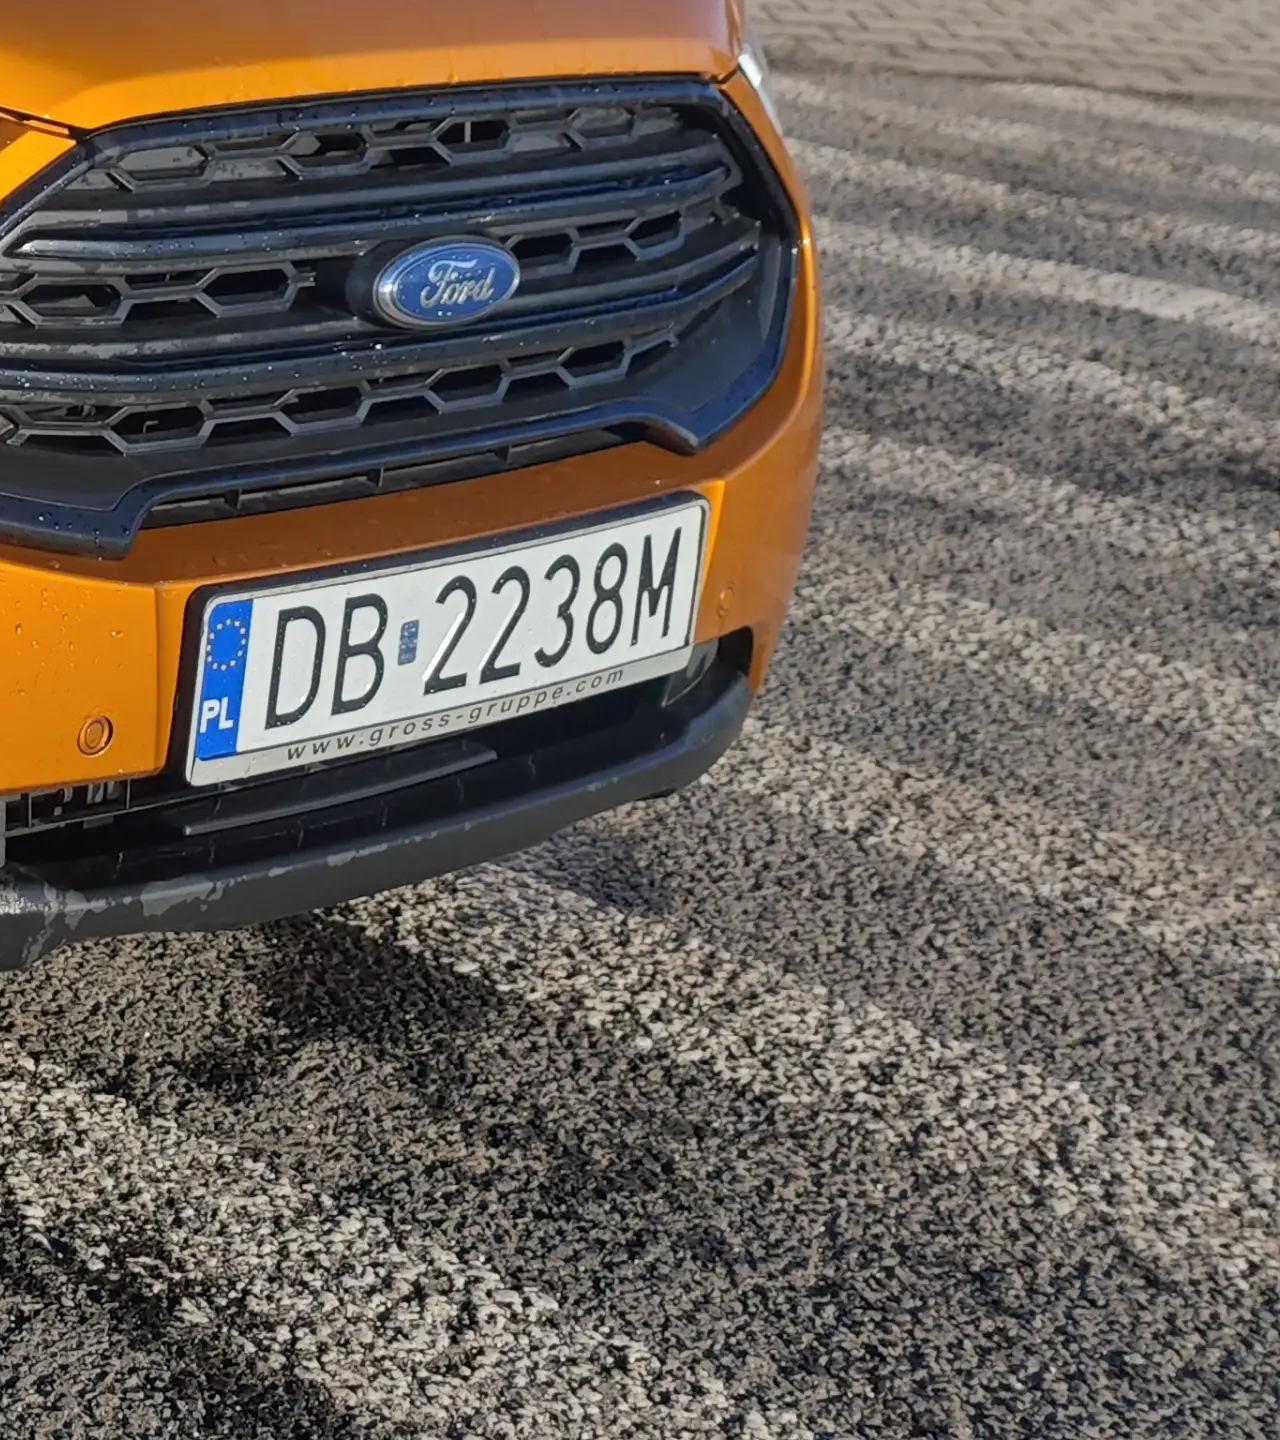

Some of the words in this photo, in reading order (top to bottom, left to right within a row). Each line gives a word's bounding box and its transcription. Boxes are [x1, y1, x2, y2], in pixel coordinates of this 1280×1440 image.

[420, 258, 496, 309] Ford
[264, 593, 388, 730] DB
[423, 526, 682, 696] 2238M
[199, 699, 235, 734] PL
[286, 667, 625, 762] www.gross-gruppe.com
